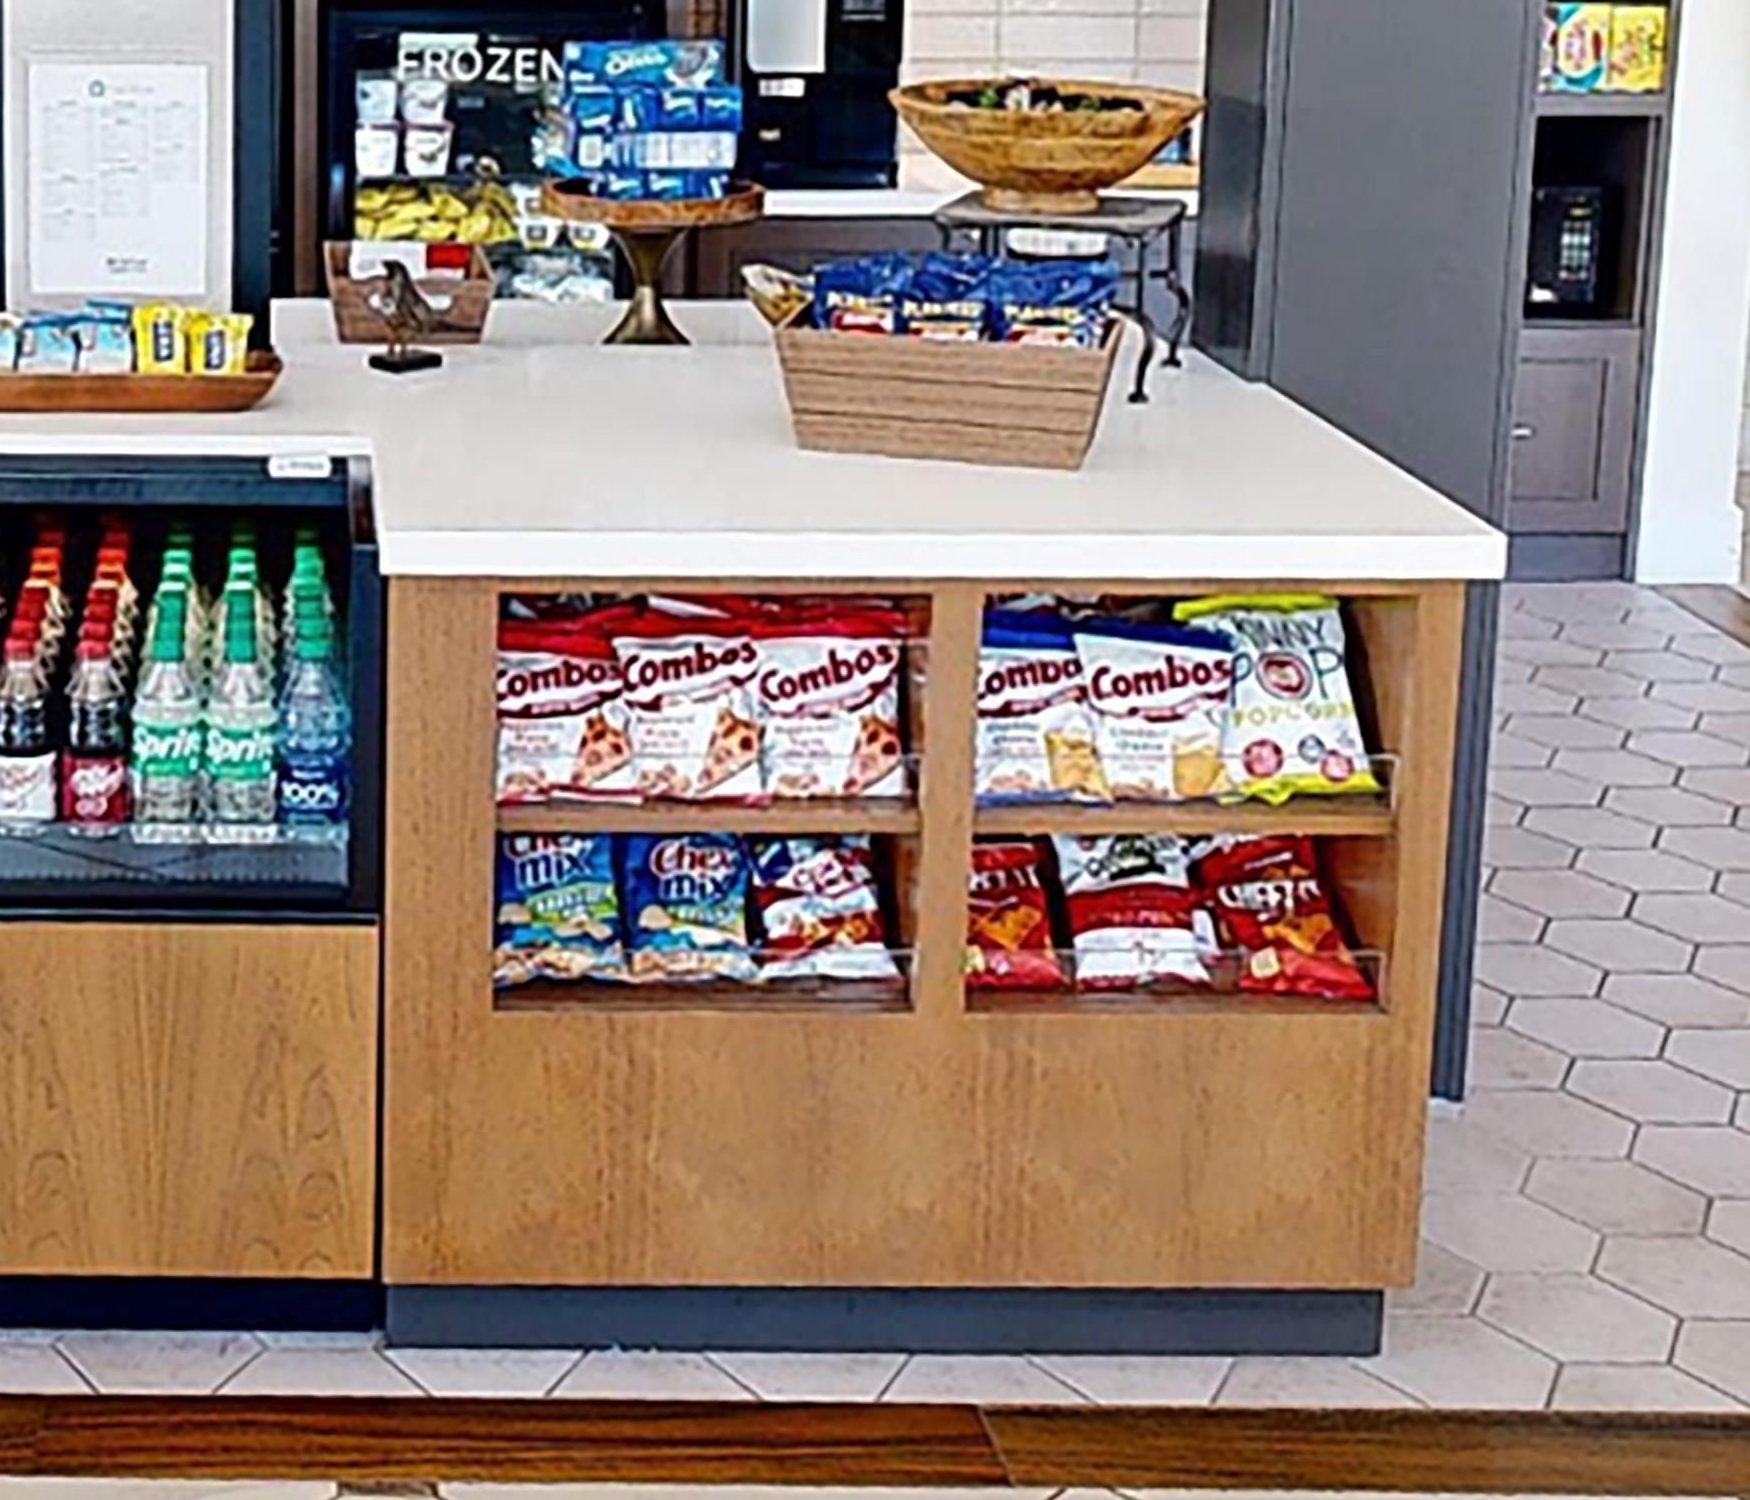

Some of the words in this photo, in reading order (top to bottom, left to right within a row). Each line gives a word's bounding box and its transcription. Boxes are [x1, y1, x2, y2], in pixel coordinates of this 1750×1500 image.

[397, 46, 566, 82] FROZEN
[622, 642, 758, 693] Combos
[759, 644, 896, 701] Combos
[1090, 654, 1232, 701] Combos
[132, 724, 202, 763] Sprit
[206, 726, 276, 764] Sprit
[515, 853, 593, 891] mix
[652, 839, 735, 879] Chex
[659, 872, 728, 900] mix
